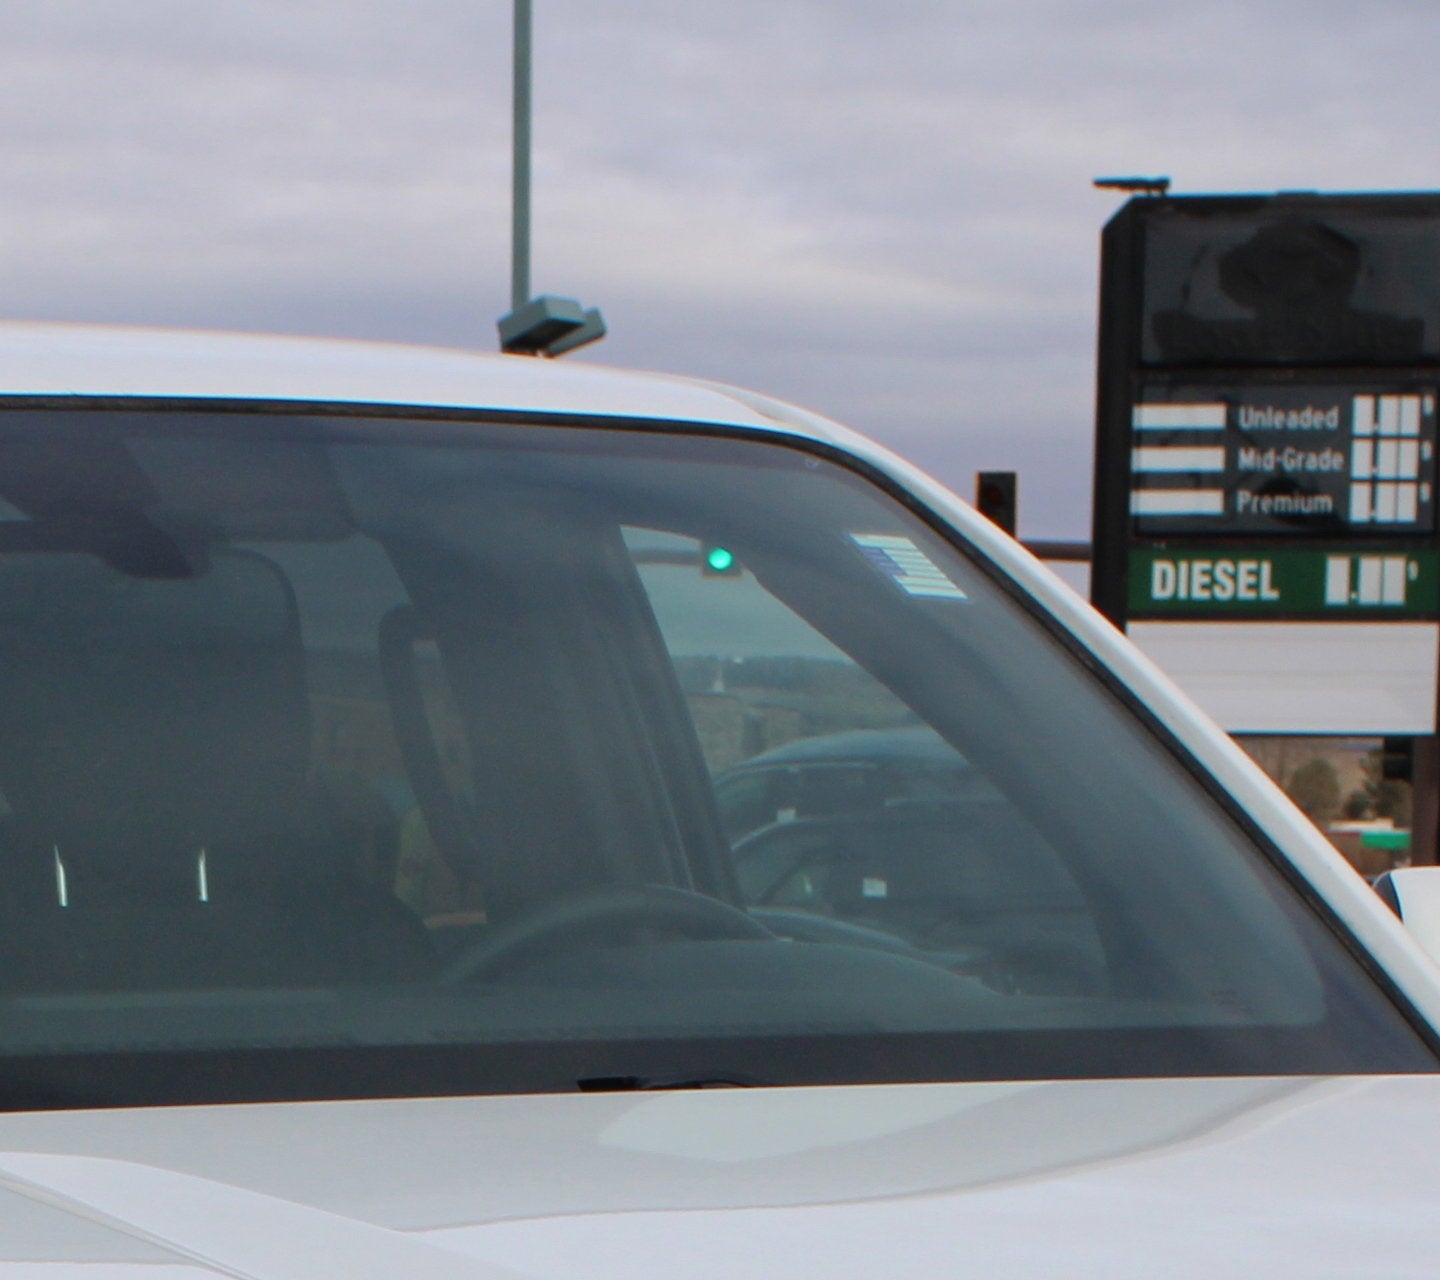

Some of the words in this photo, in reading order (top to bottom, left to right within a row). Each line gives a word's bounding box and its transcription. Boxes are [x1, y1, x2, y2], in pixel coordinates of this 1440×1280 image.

[1238, 404, 1340, 430] Unleaded
[1237, 446, 1345, 473] Mid-Grade
[1236, 489, 1334, 516] Premium
[1151, 558, 1281, 601] DIESEL
